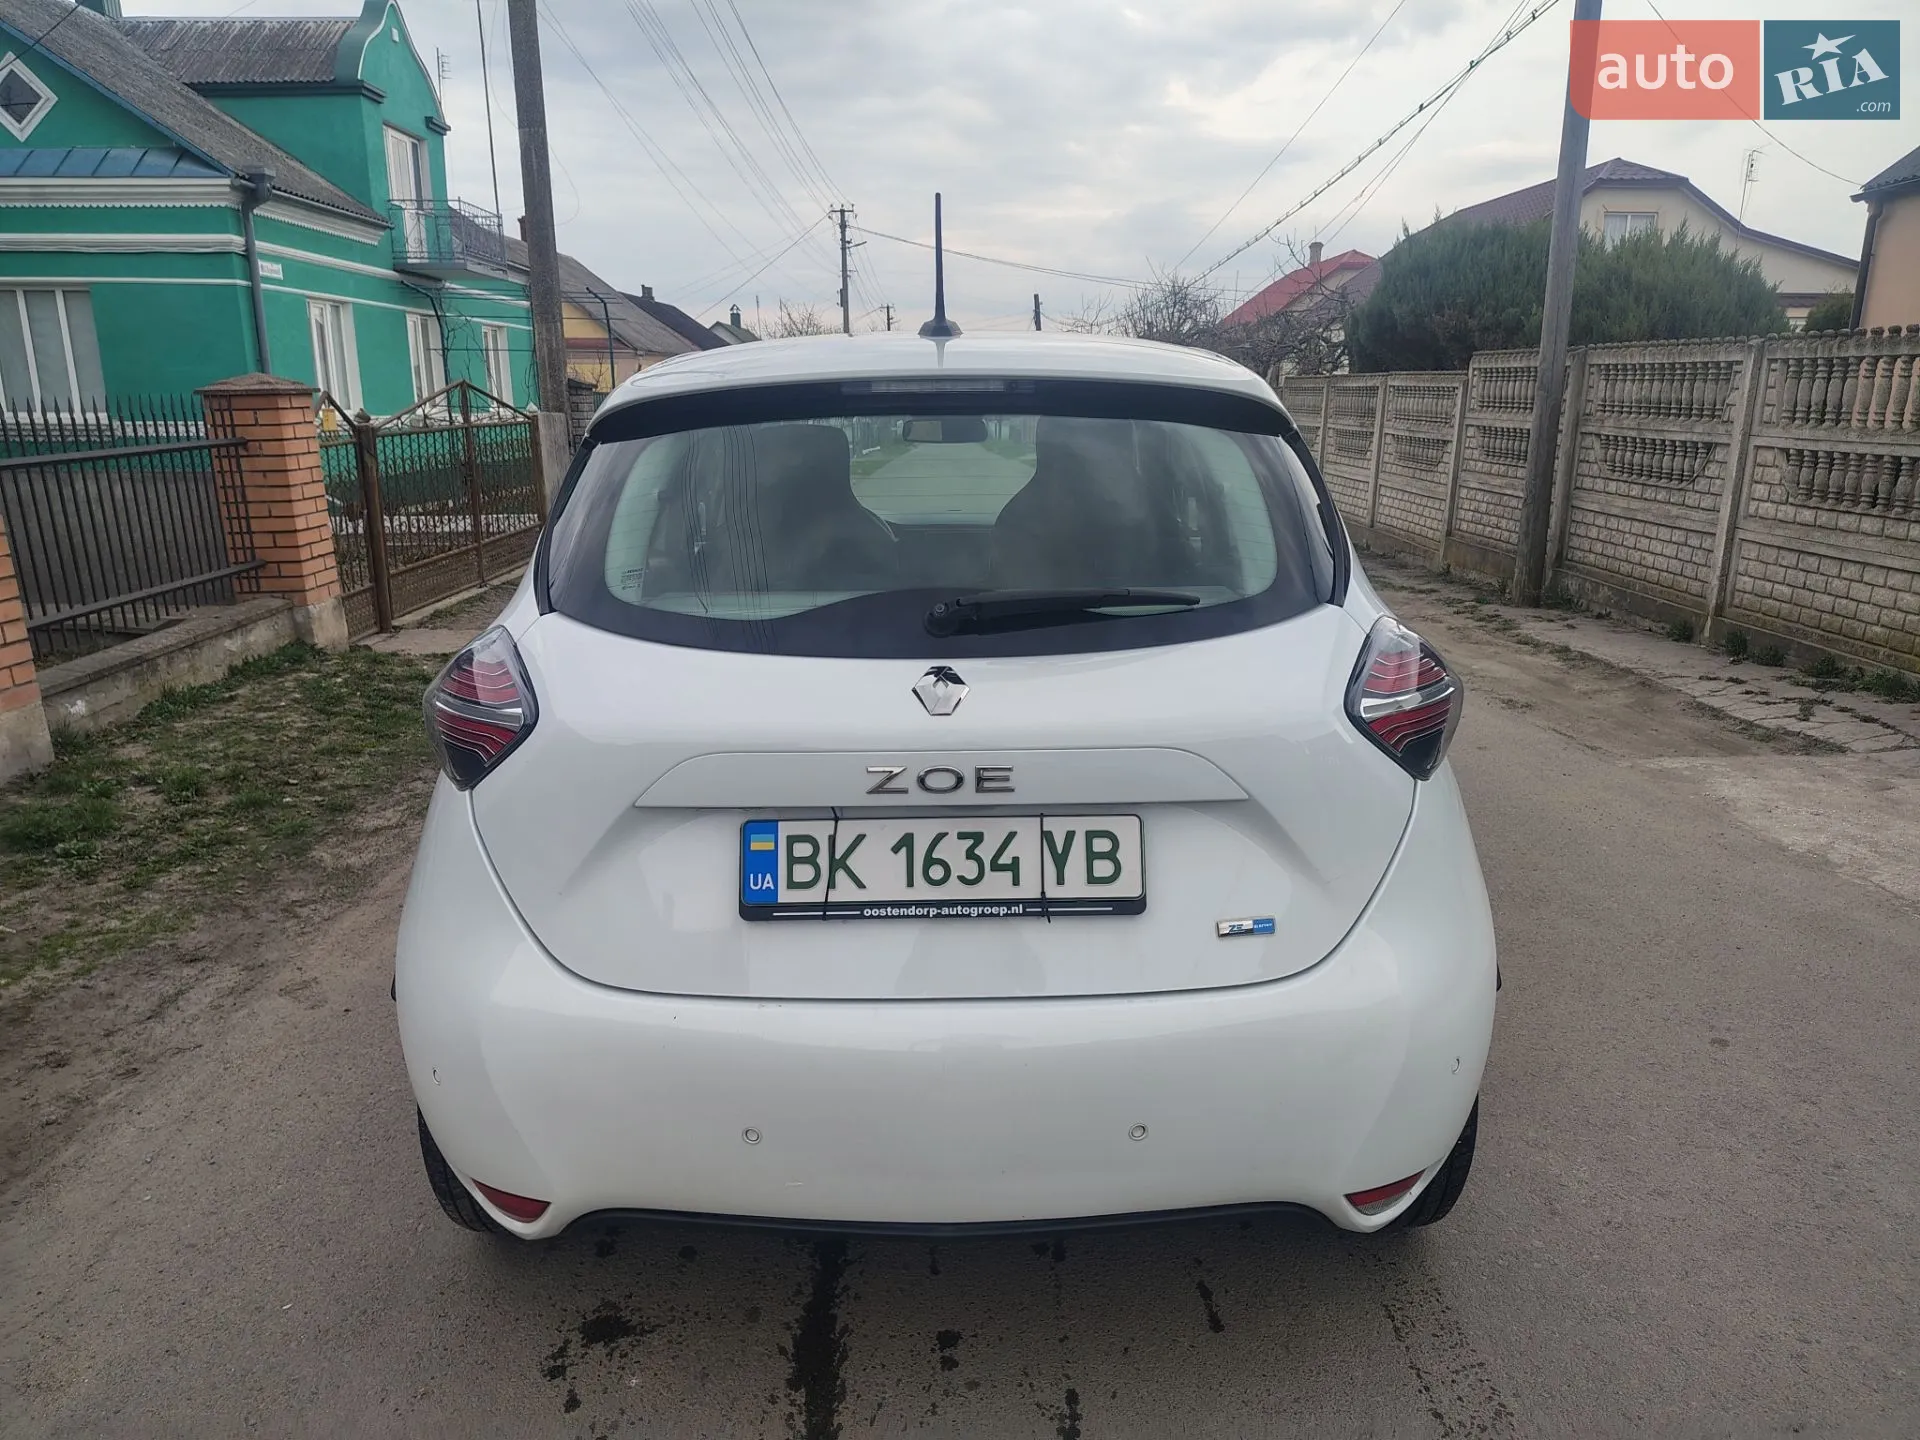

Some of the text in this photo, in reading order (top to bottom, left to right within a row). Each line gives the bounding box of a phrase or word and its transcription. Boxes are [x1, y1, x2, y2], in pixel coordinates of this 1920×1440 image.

[866, 765, 1016, 794] ZOE
[786, 830, 1122, 890] BK 1634 YB
[750, 873, 775, 890] UA
[863, 904, 1023, 918] oostendorp-autogroep.nl
